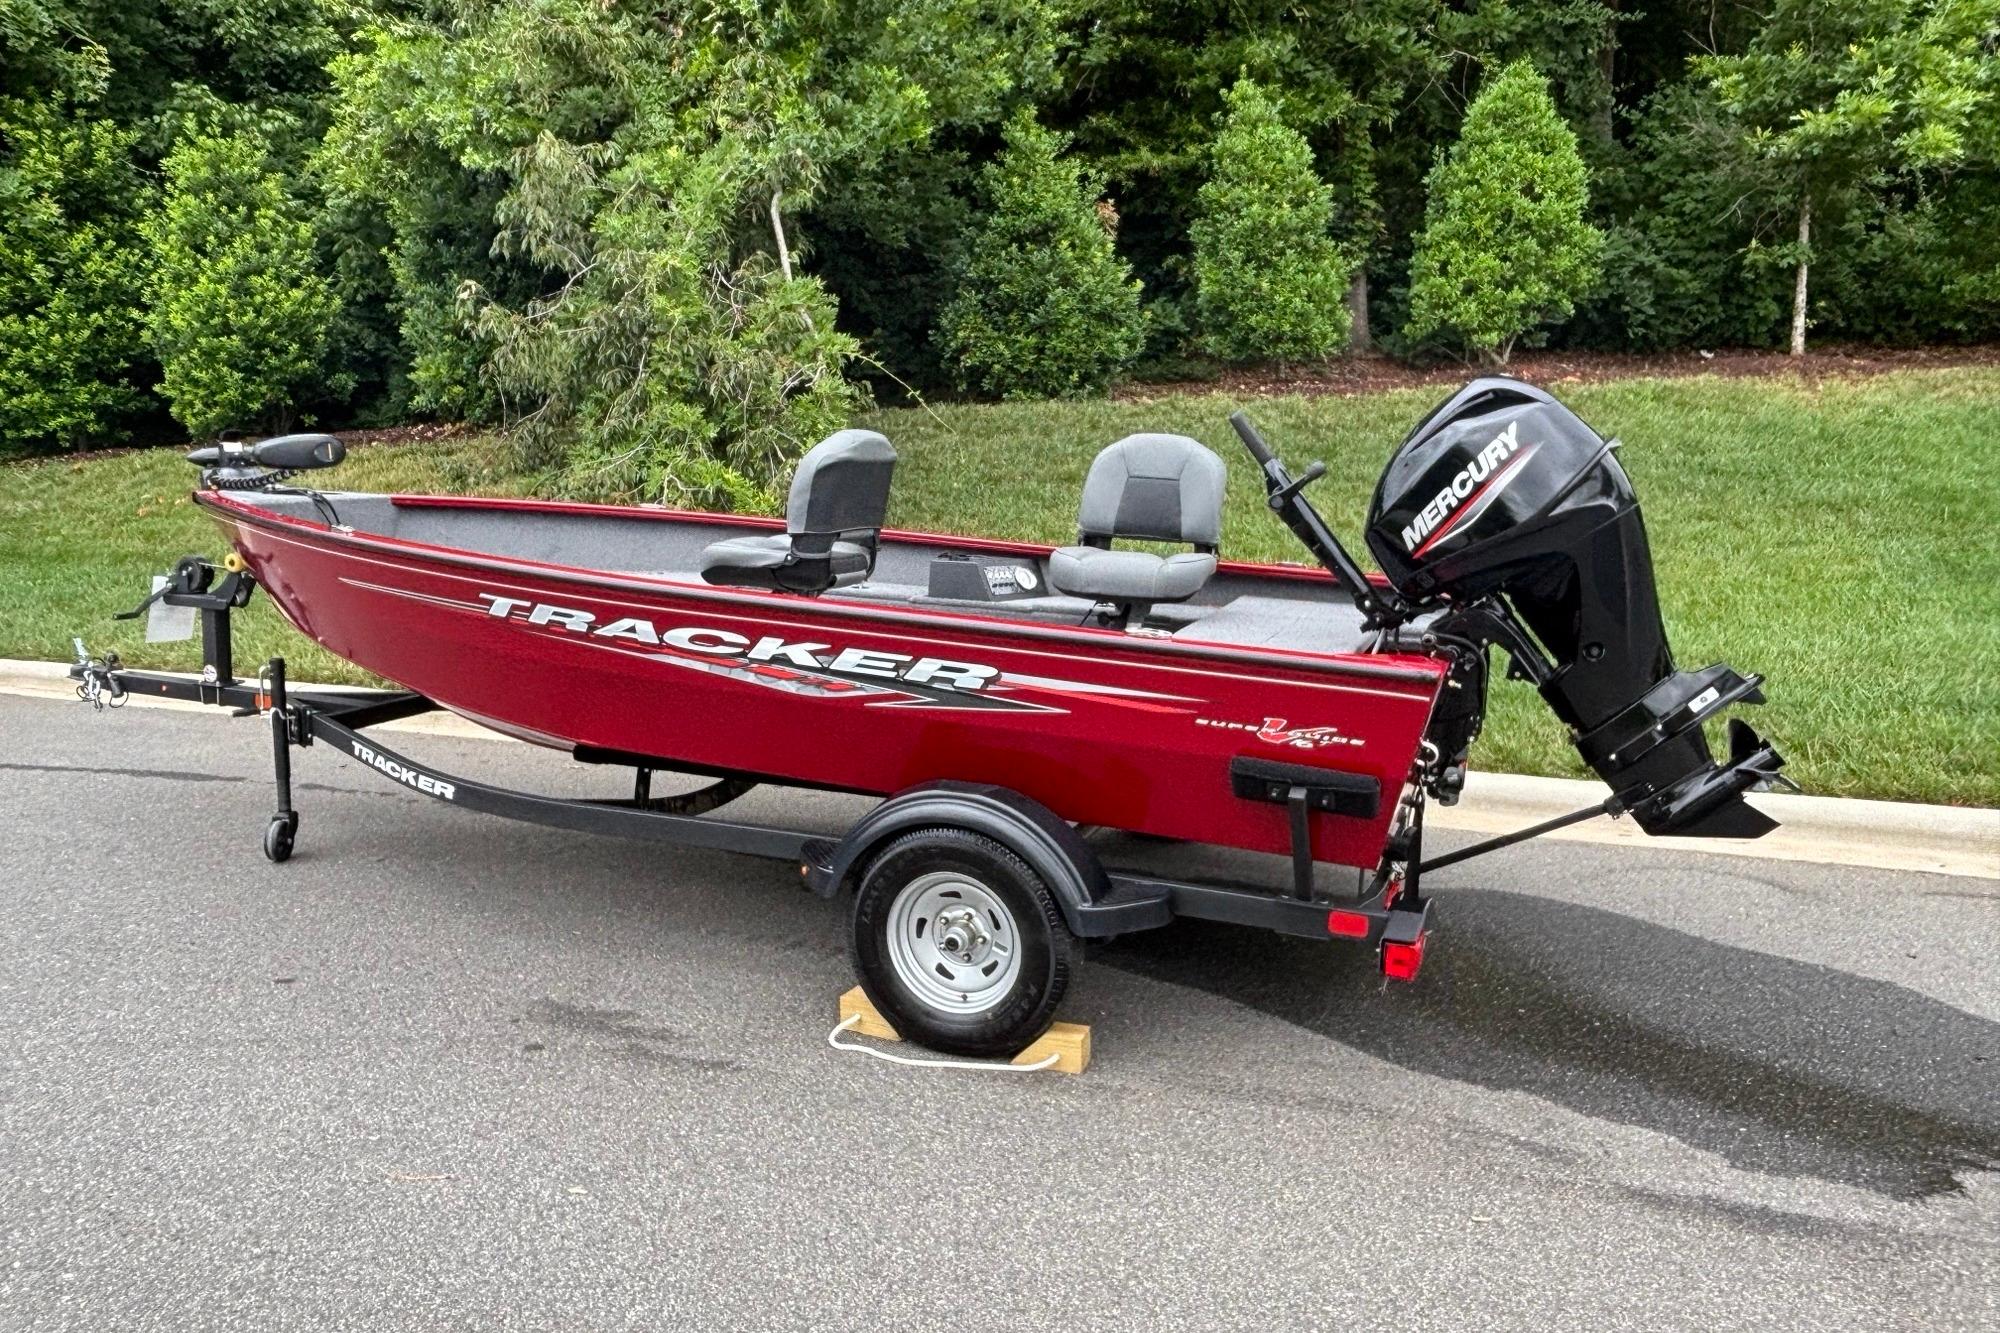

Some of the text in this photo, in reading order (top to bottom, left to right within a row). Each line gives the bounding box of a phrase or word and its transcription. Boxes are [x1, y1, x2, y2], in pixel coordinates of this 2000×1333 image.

[1401, 420, 1518, 551] MERCURY
[479, 592, 1002, 691] TRACKER
[351, 740, 456, 800] TRACKER
